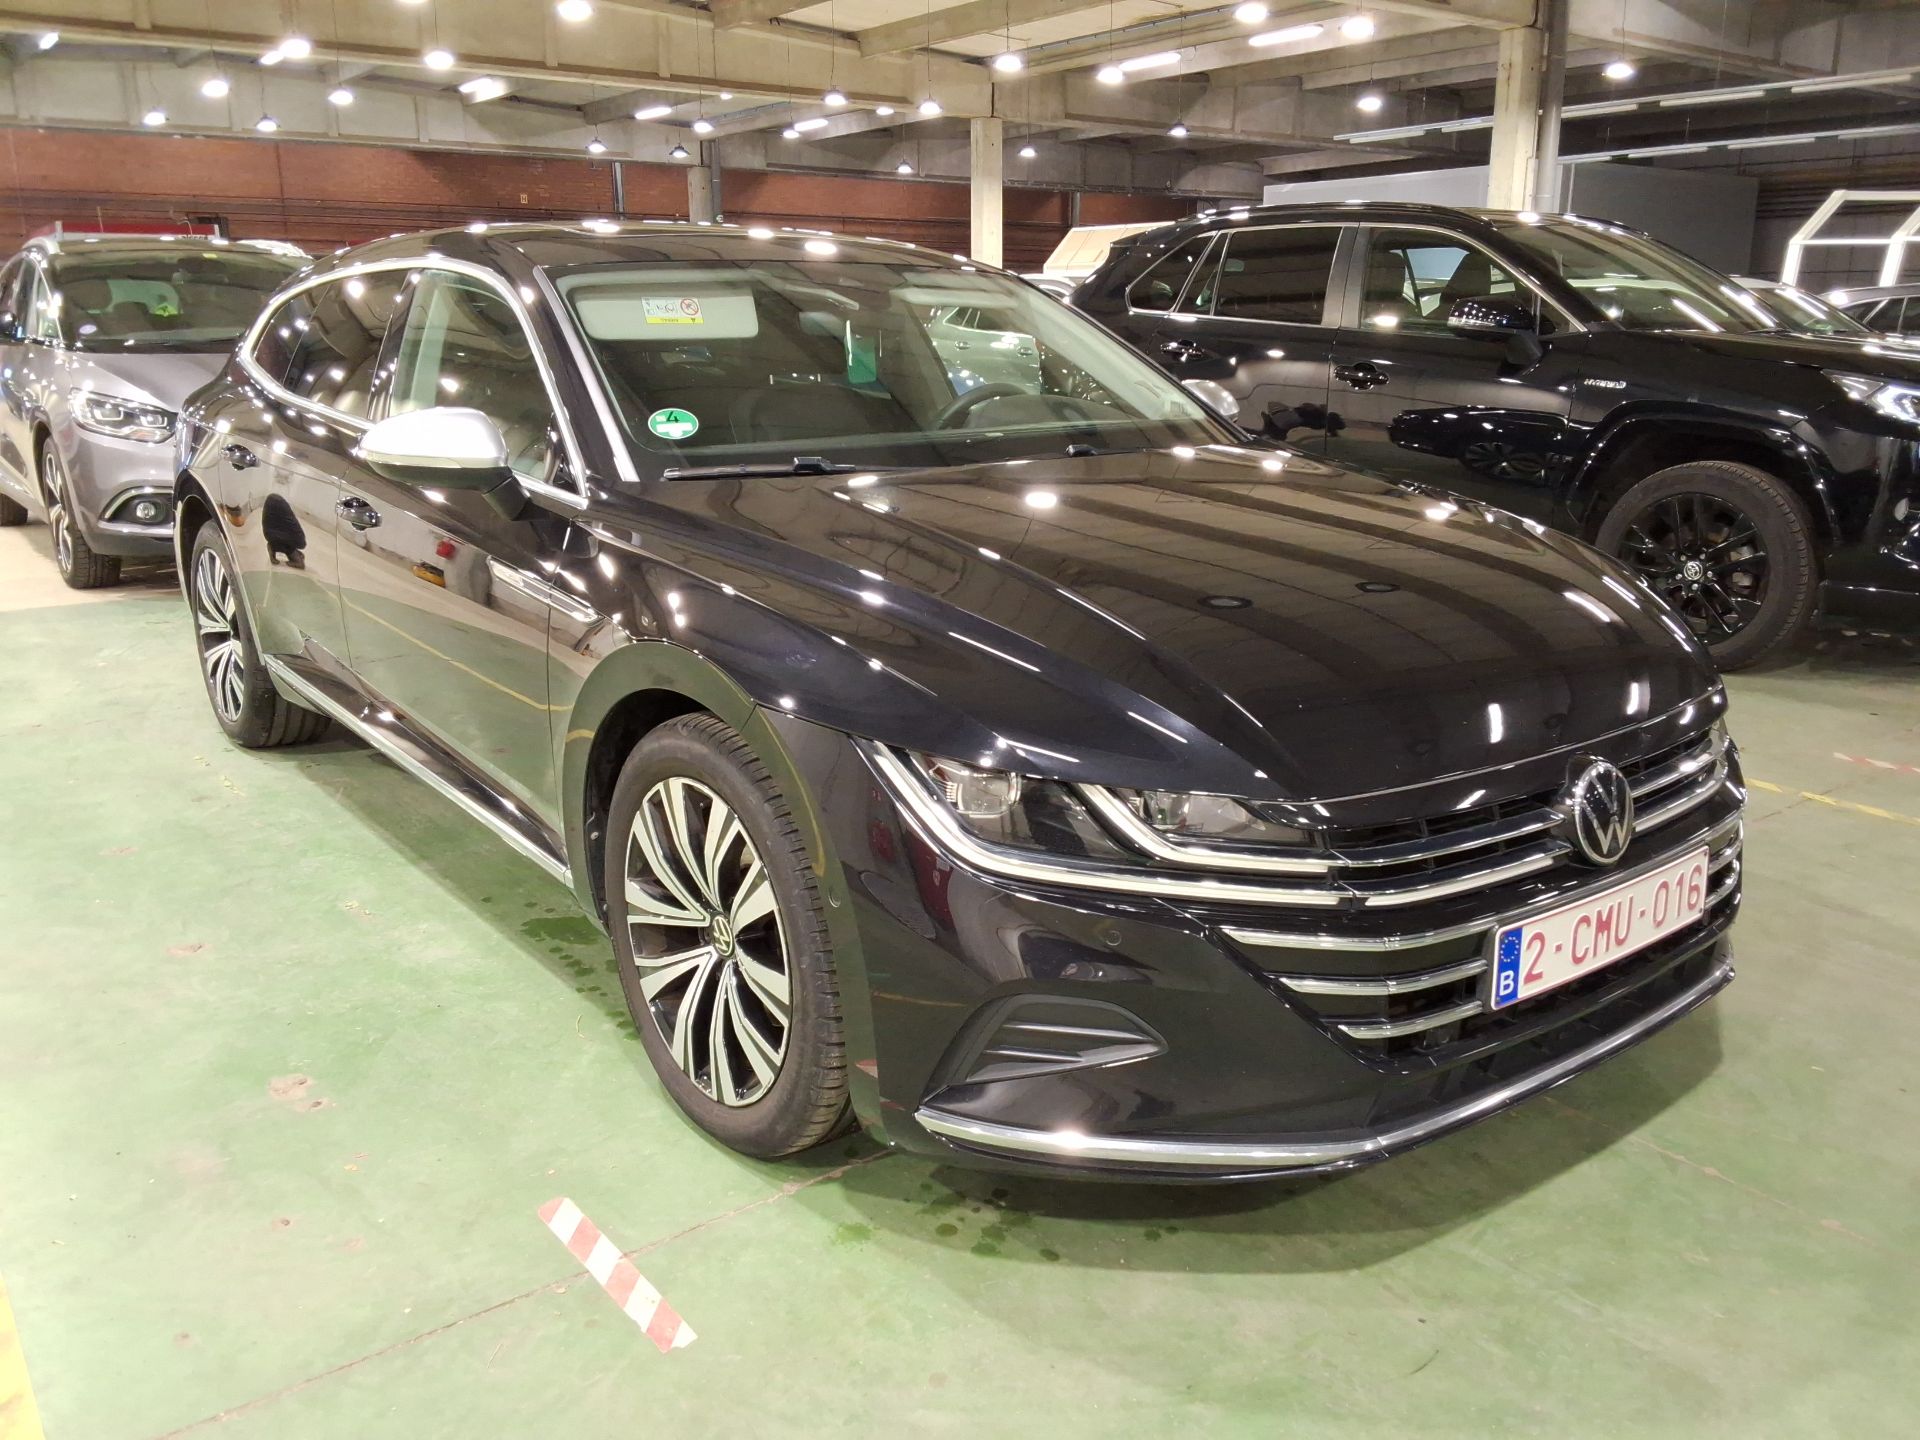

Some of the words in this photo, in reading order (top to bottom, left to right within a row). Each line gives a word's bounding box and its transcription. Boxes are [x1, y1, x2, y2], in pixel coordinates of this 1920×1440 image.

[666, 410, 680, 423] 4
[1499, 969, 1515, 996] B
[1523, 863, 1703, 986] 2-CMU-016
